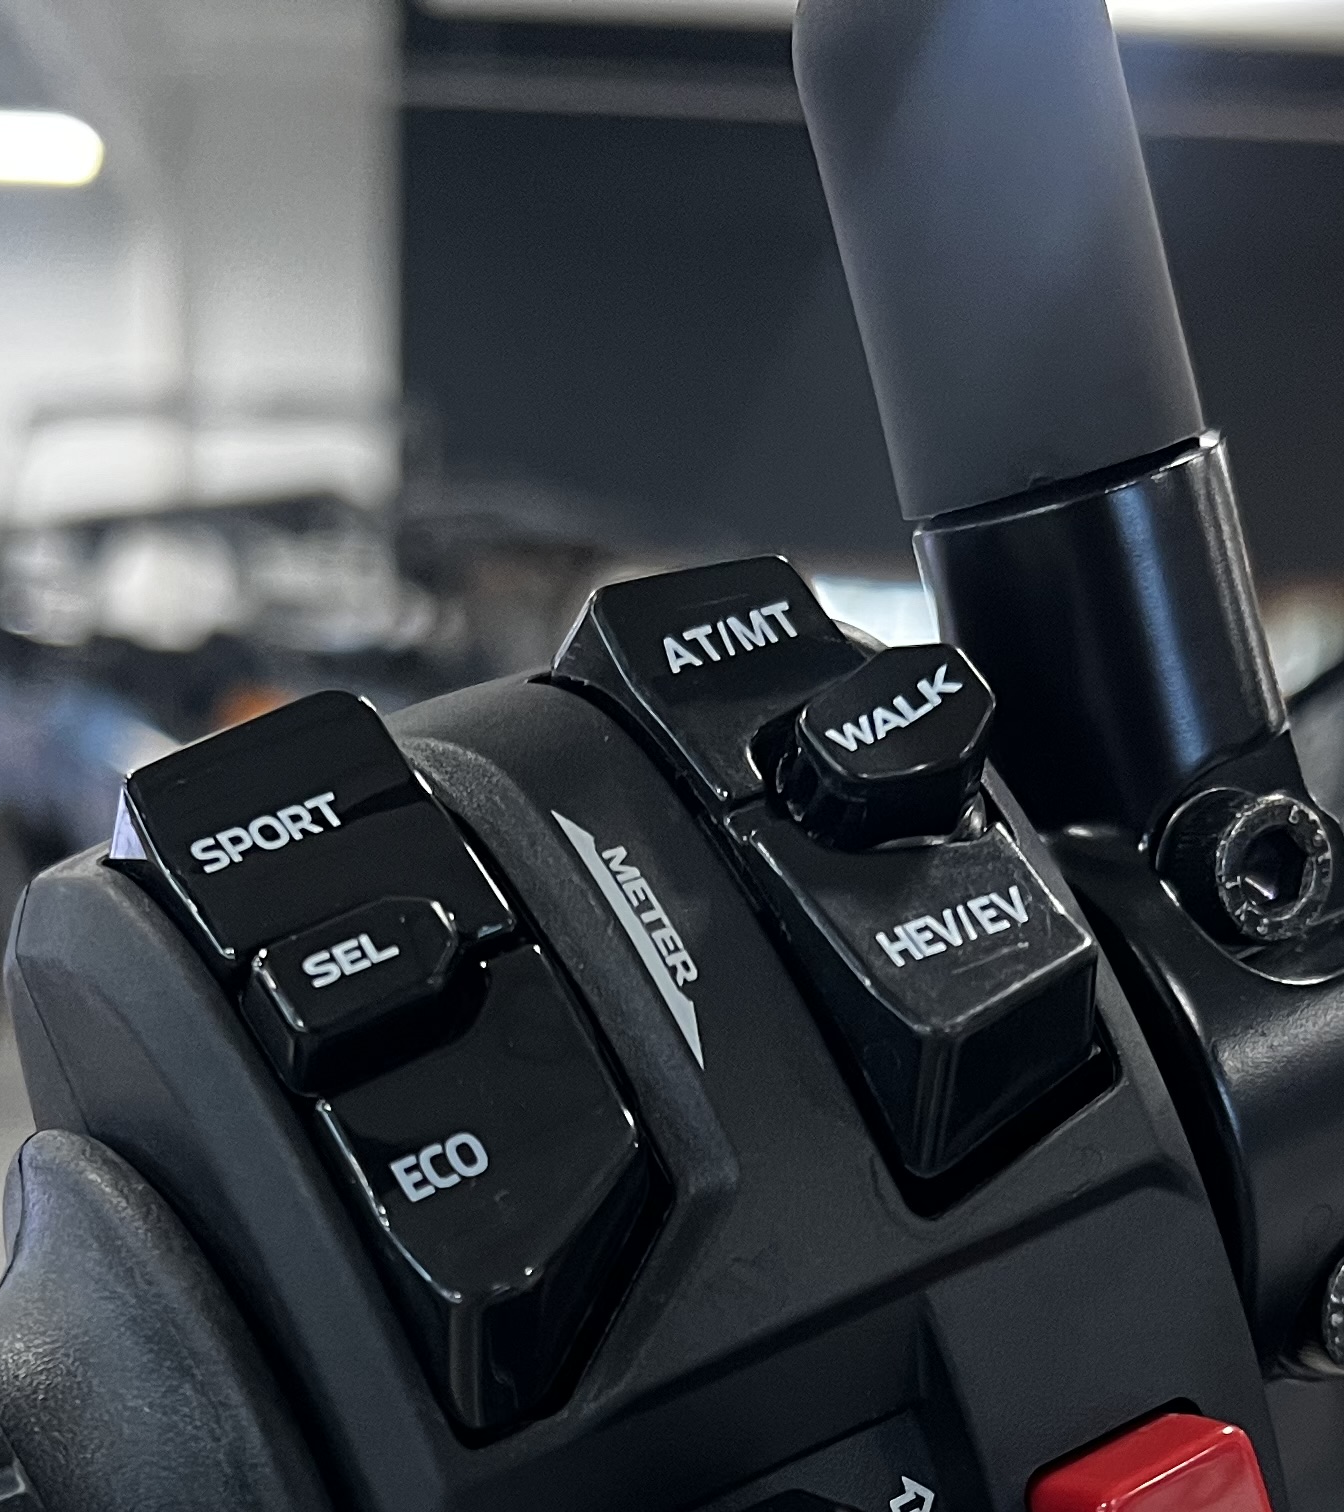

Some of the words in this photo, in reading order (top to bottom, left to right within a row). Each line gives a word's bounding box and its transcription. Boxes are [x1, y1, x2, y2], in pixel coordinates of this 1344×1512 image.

[662, 600, 799, 675] AT/MT
[823, 662, 964, 753] WALK
[189, 791, 342, 874] SPORT
[602, 846, 698, 987] METER
[874, 885, 1030, 968] HEV/EV
[301, 932, 400, 989] SEL
[389, 1132, 490, 1203] ECO
